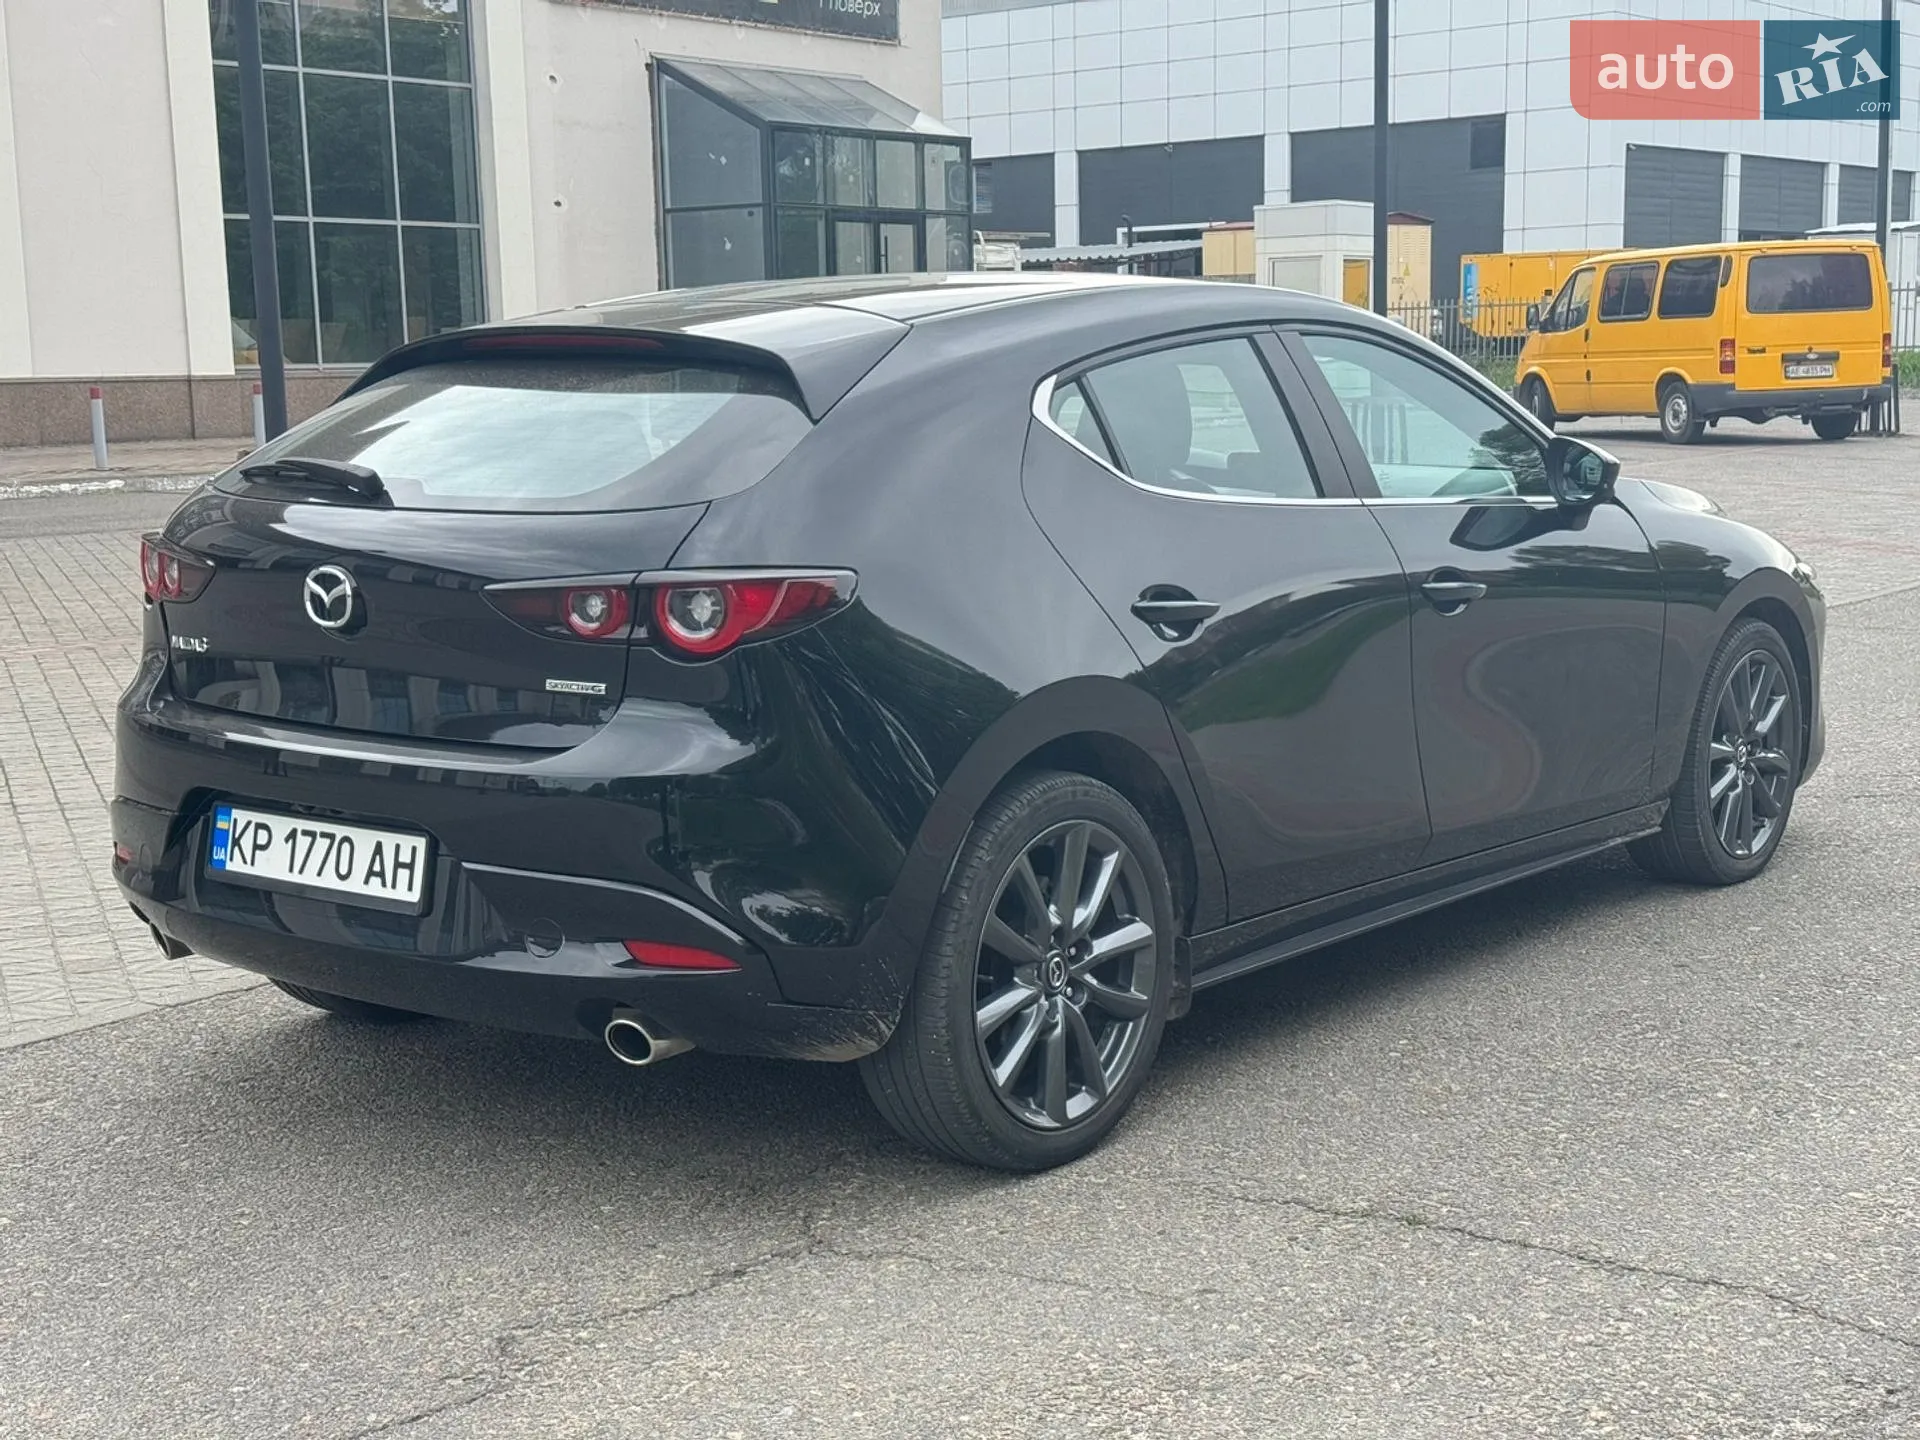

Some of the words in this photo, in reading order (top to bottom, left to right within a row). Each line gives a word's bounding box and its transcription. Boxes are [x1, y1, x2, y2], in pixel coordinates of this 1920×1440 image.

[212, 847, 226, 861] UA
[229, 817, 273, 867] KP
[283, 827, 355, 882] 1770
[363, 840, 418, 892] AH
